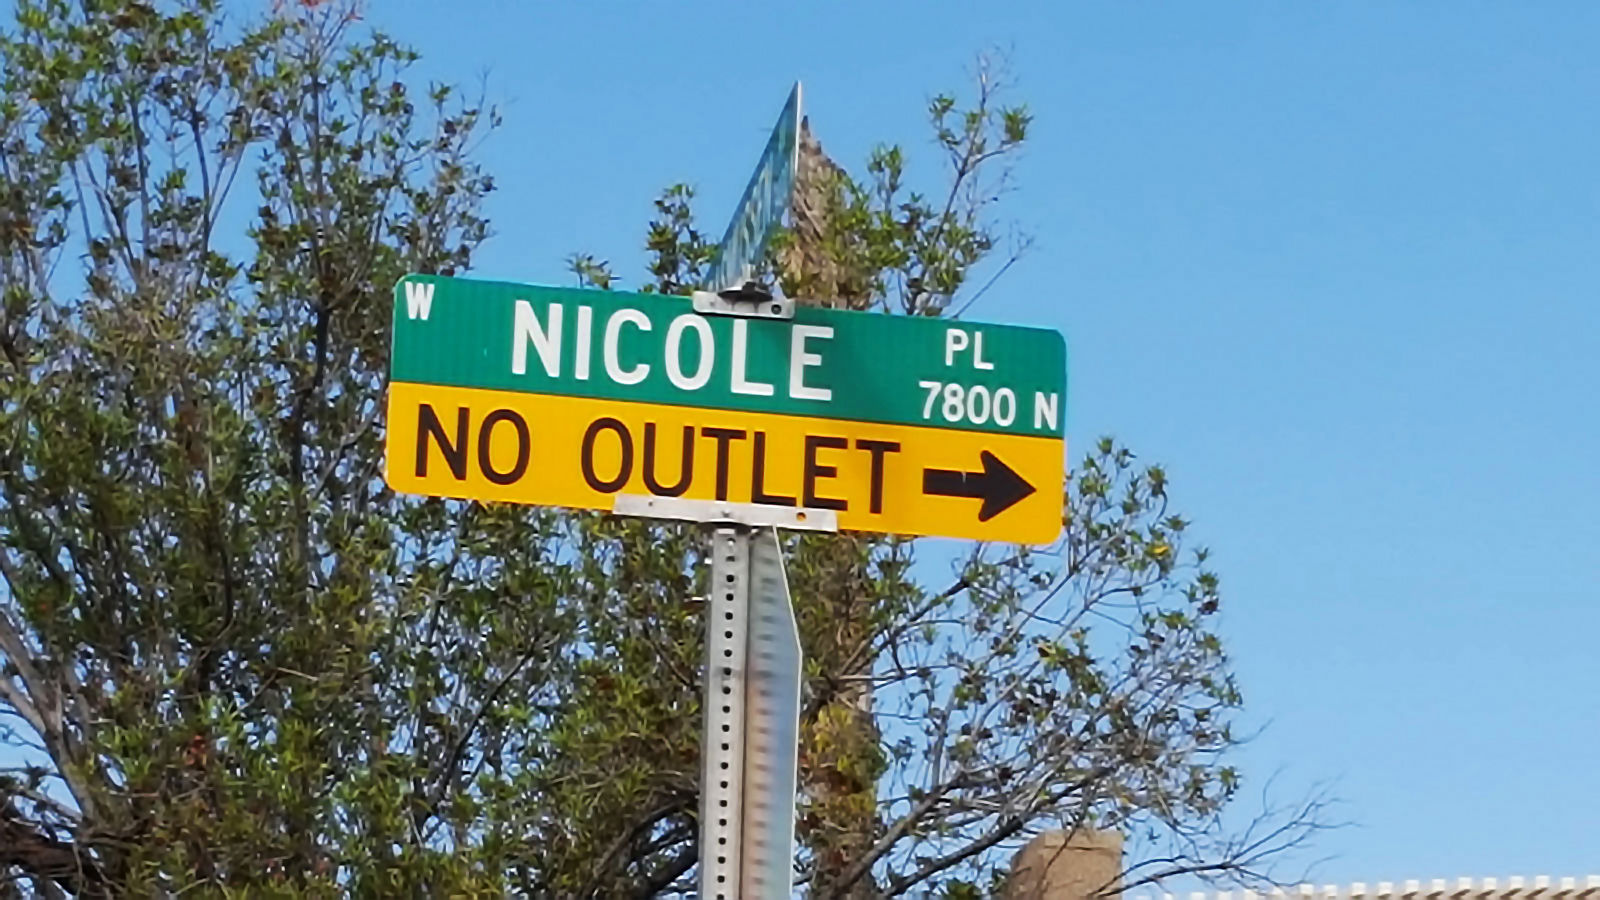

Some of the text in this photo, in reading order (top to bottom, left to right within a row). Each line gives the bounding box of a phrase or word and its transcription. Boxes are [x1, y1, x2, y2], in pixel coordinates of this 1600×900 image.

[405, 283, 994, 403] W NICOLE PL
[414, 403, 901, 515] NO OUTLET
[918, 380, 1059, 432] 7800 N
